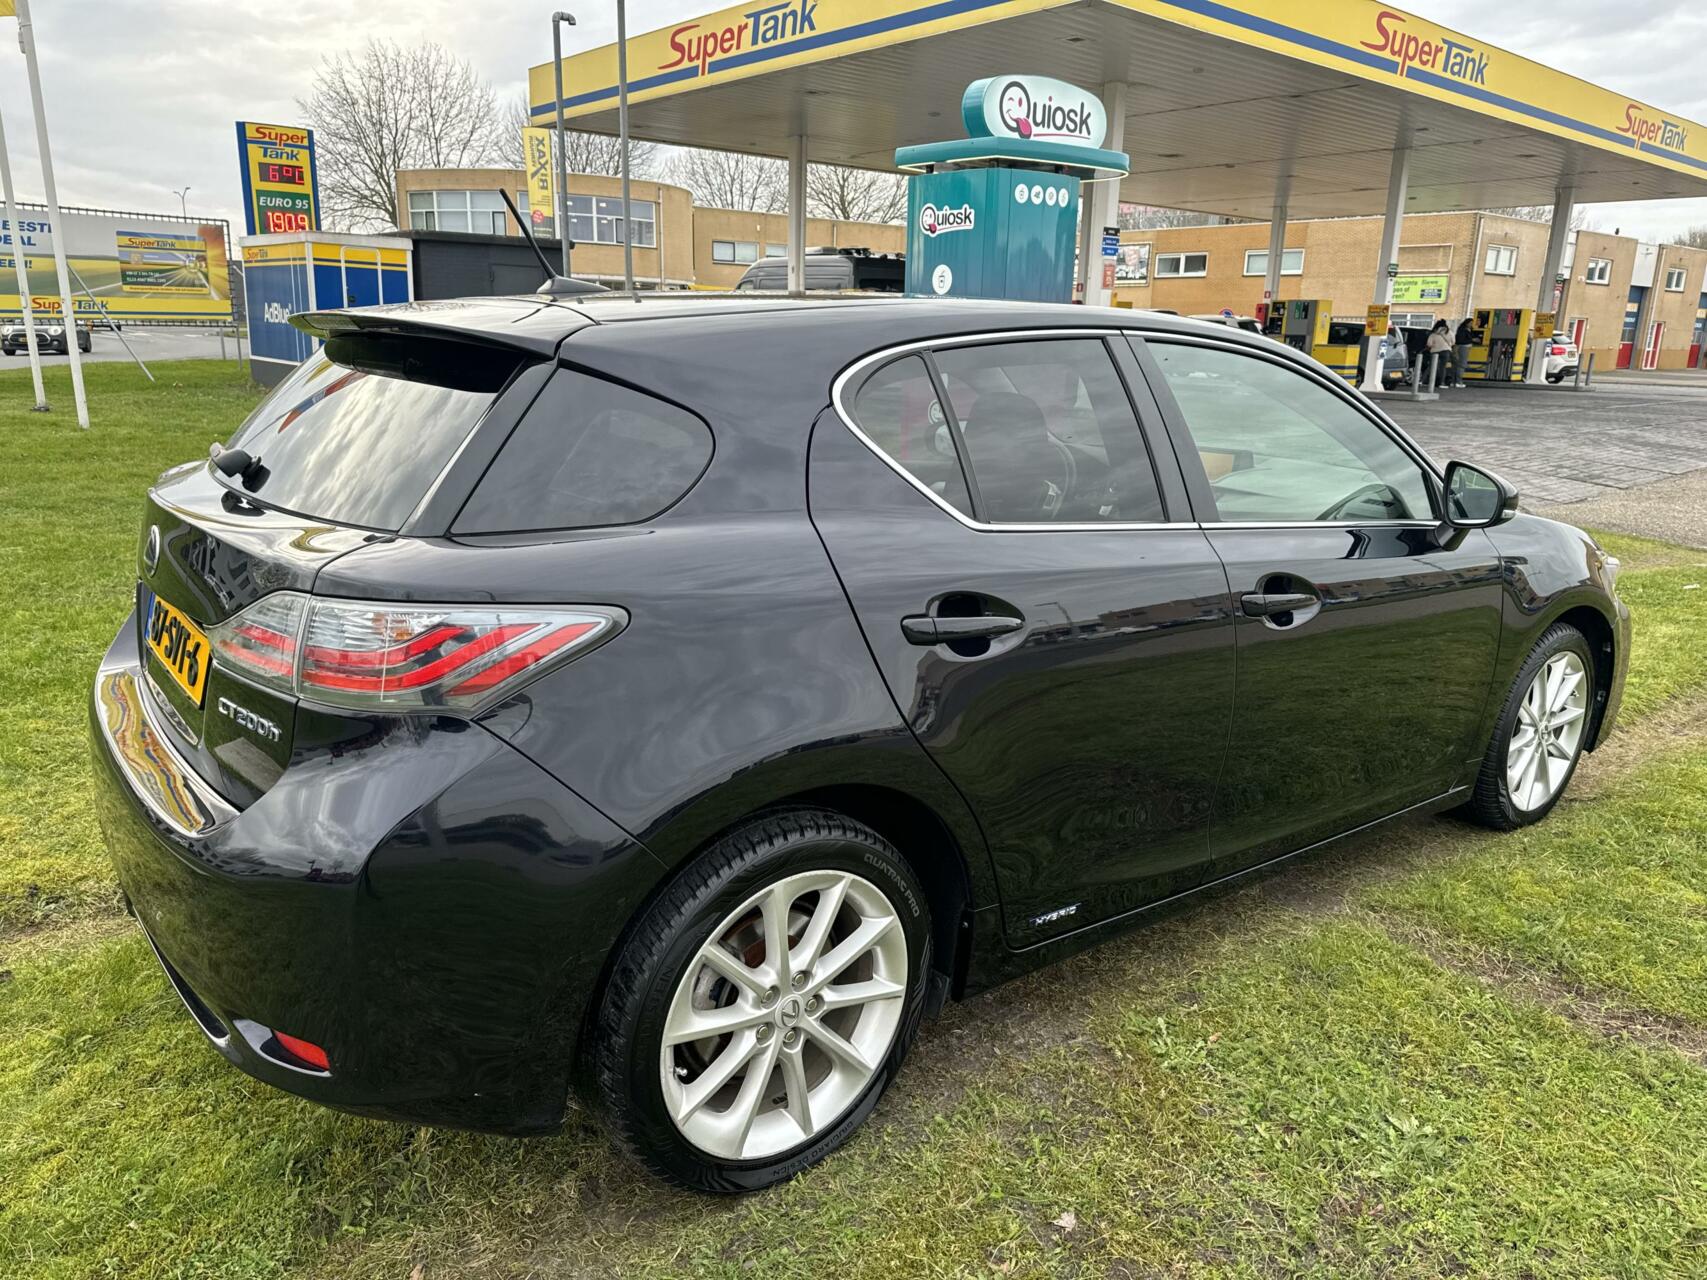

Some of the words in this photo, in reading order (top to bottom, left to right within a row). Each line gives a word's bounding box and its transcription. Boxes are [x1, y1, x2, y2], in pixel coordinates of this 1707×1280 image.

[657, 0, 818, 76] SuperTank
[1360, 10, 1488, 85] SuperTank
[1000, 80, 1092, 139] Quiosk
[247, 126, 307, 147] Super
[1616, 103, 1688, 152] SuperTank
[257, 146, 300, 161] Tank
[259, 197, 292, 208] EURO
[295, 199, 309, 209] 95
[922, 206, 973, 234] Quiosk
[127, 237, 176, 249] SuperTank
[32, 297, 108, 314] SupTank
[904, 889, 920, 918] PRO
